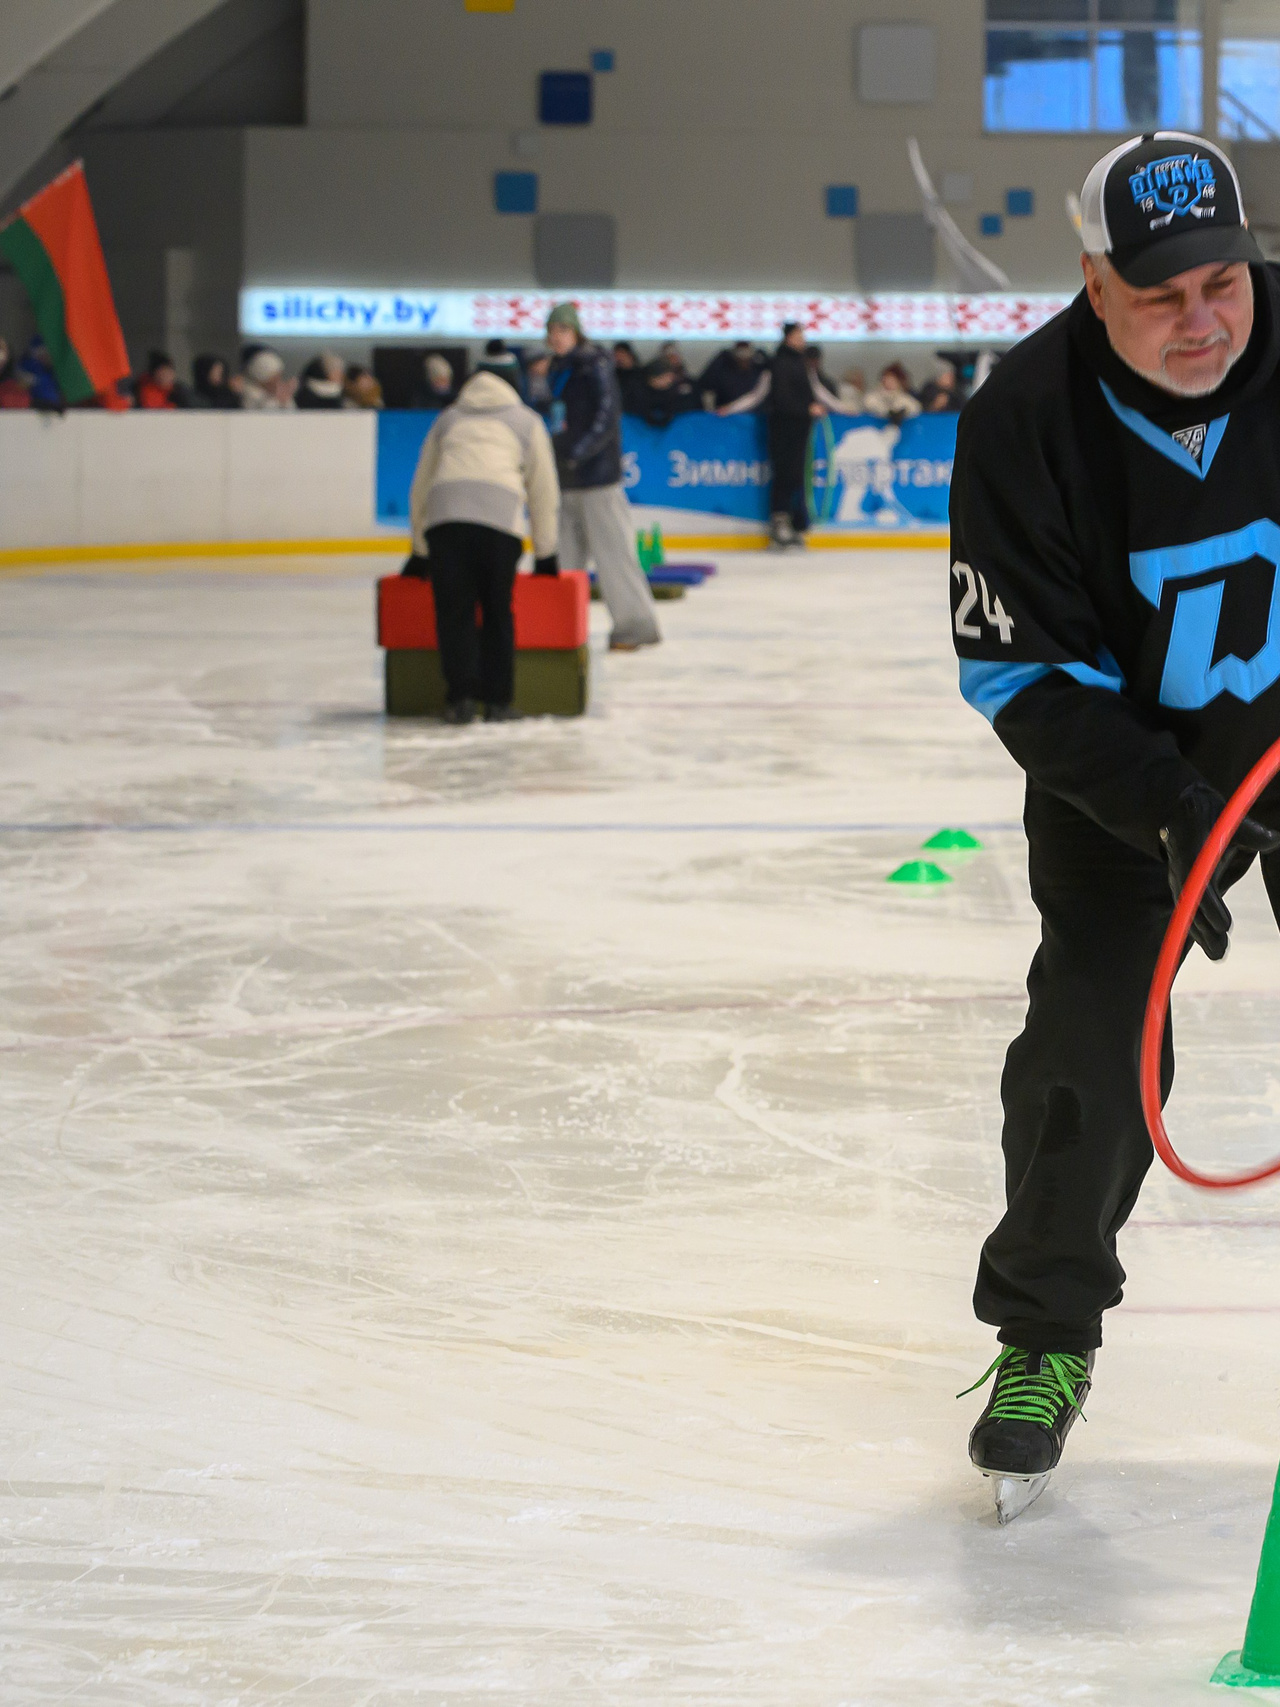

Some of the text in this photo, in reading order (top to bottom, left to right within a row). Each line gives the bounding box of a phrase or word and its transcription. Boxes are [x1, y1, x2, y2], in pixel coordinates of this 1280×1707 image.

[1130, 161, 1215, 197] DINAMO
[263, 292, 438, 330] silichy.by
[667, 449, 772, 488] Зимн
[951, 560, 1015, 645] 24
